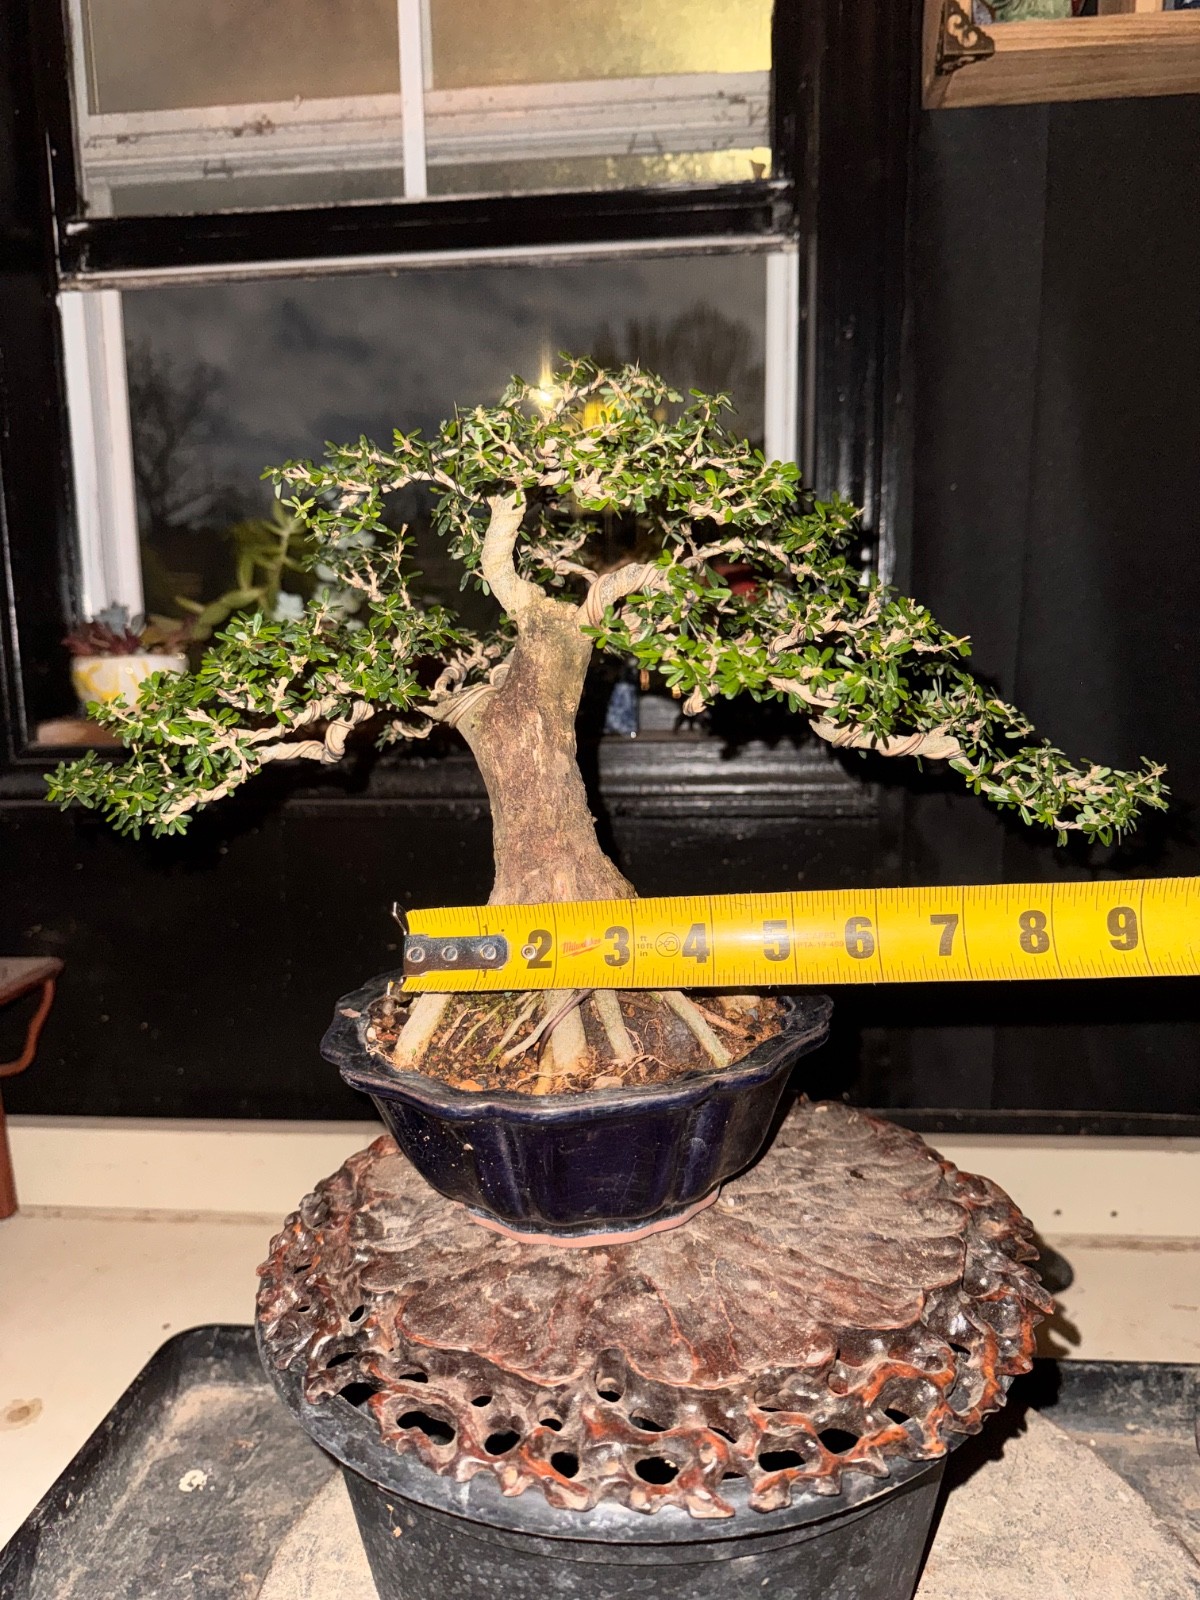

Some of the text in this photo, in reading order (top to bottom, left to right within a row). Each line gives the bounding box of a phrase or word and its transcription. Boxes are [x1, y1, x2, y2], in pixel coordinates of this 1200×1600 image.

[526, 929, 552, 969] 2
[604, 925, 631, 967] 3
[681, 922, 711, 963] 4
[762, 919, 790, 961] 5
[844, 916, 875, 959] 6
[930, 913, 960, 957] 7
[1018, 910, 1050, 954] 8
[1106, 906, 1138, 951] 9
